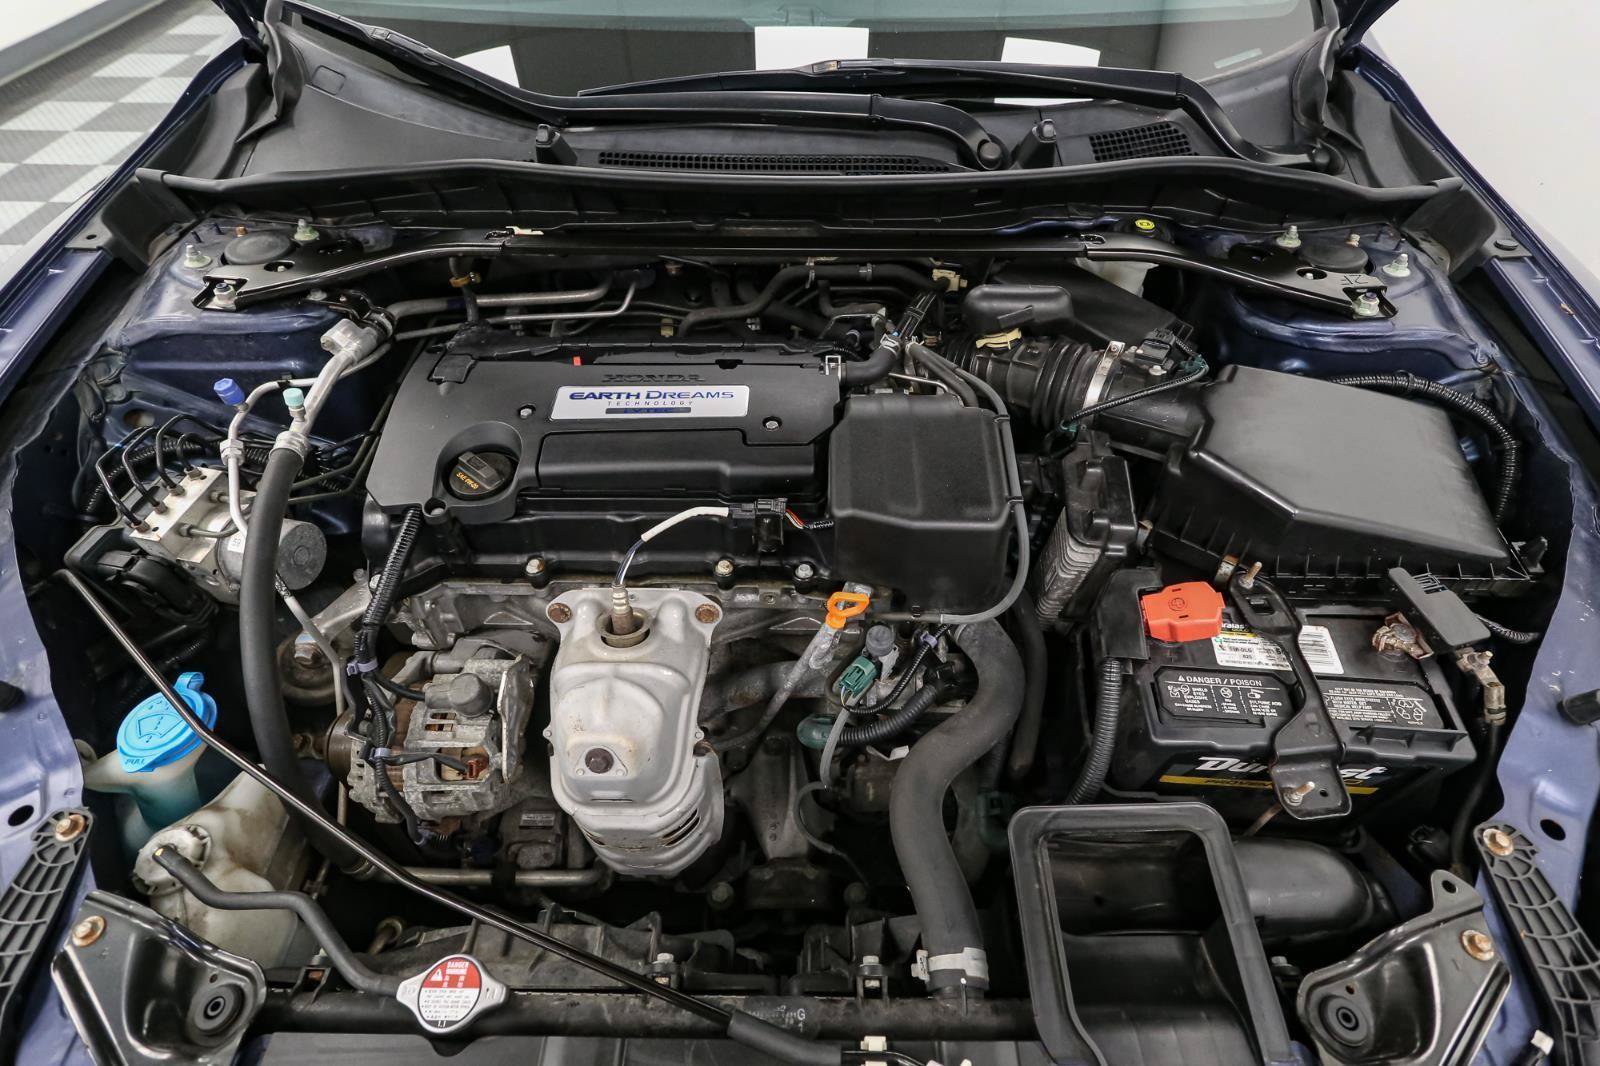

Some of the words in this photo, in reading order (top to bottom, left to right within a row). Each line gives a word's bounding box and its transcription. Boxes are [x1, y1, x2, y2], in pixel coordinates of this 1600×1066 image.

[602, 374, 706, 383] HONDA
[569, 391, 640, 400] EARTH
[645, 390, 735, 399] DREAMS
[1186, 676, 1221, 685] DANGER
[1230, 679, 1263, 687] POISON
[1196, 756, 1388, 780] Durst
